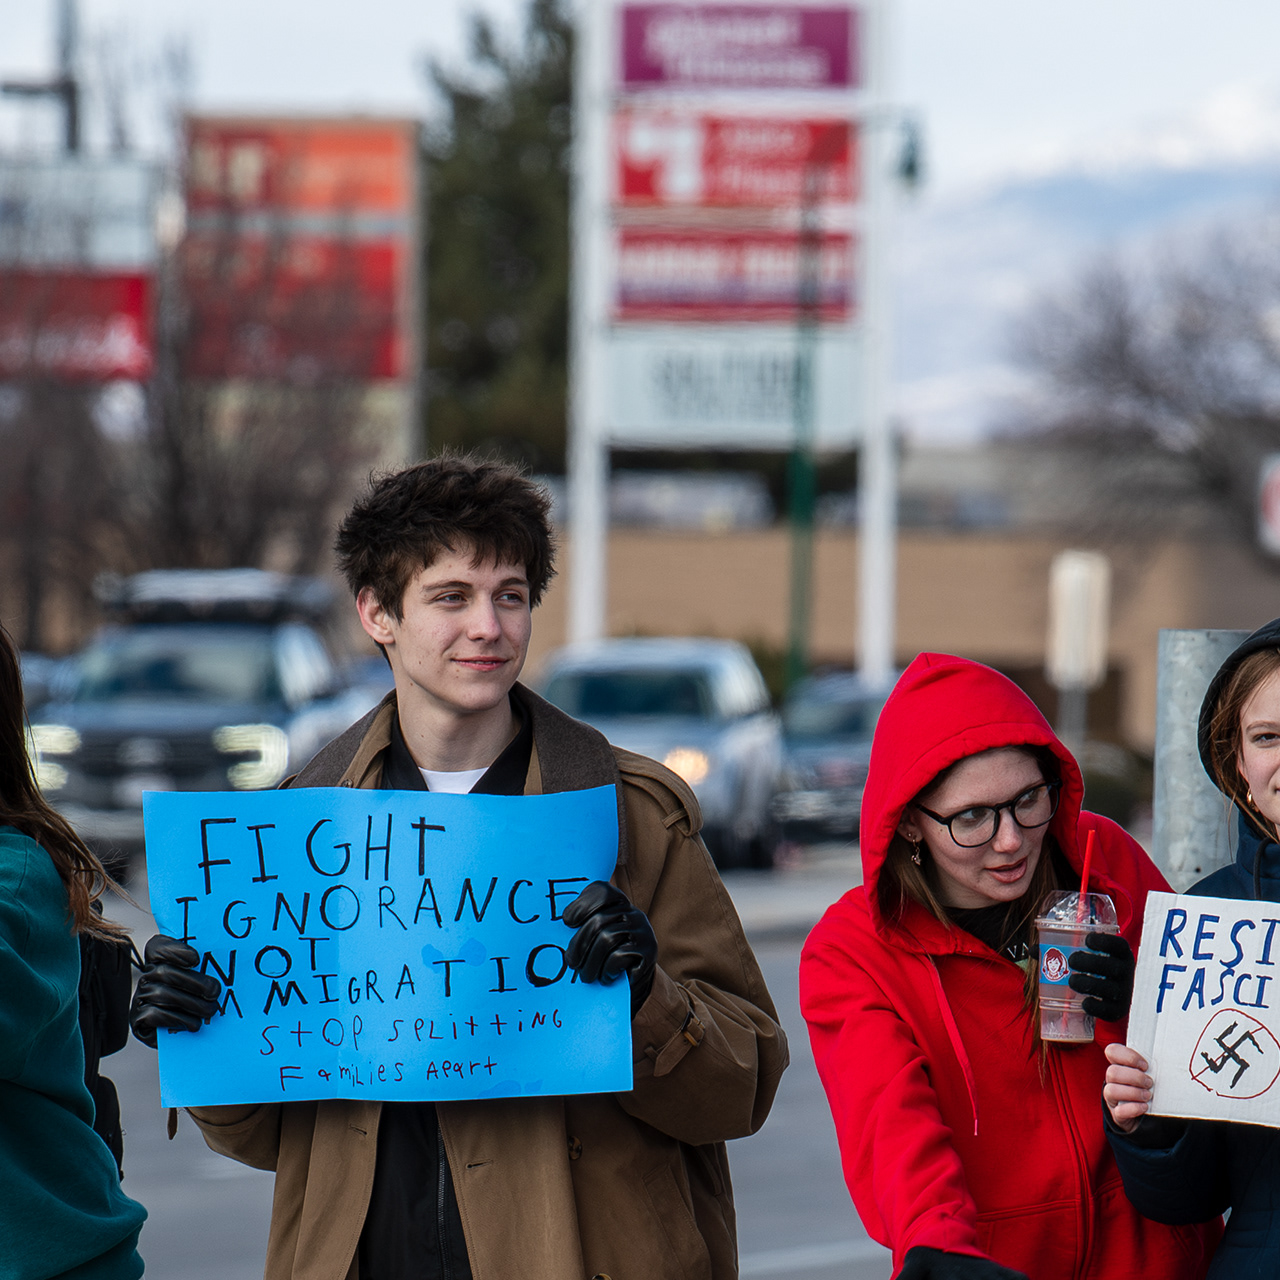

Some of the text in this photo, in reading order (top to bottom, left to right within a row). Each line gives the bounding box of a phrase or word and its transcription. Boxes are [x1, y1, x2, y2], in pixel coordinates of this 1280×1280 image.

[198, 813, 446, 896] FIGHT
[176, 876, 590, 944] IGNORANCE
[200, 937, 331, 988] NOT
